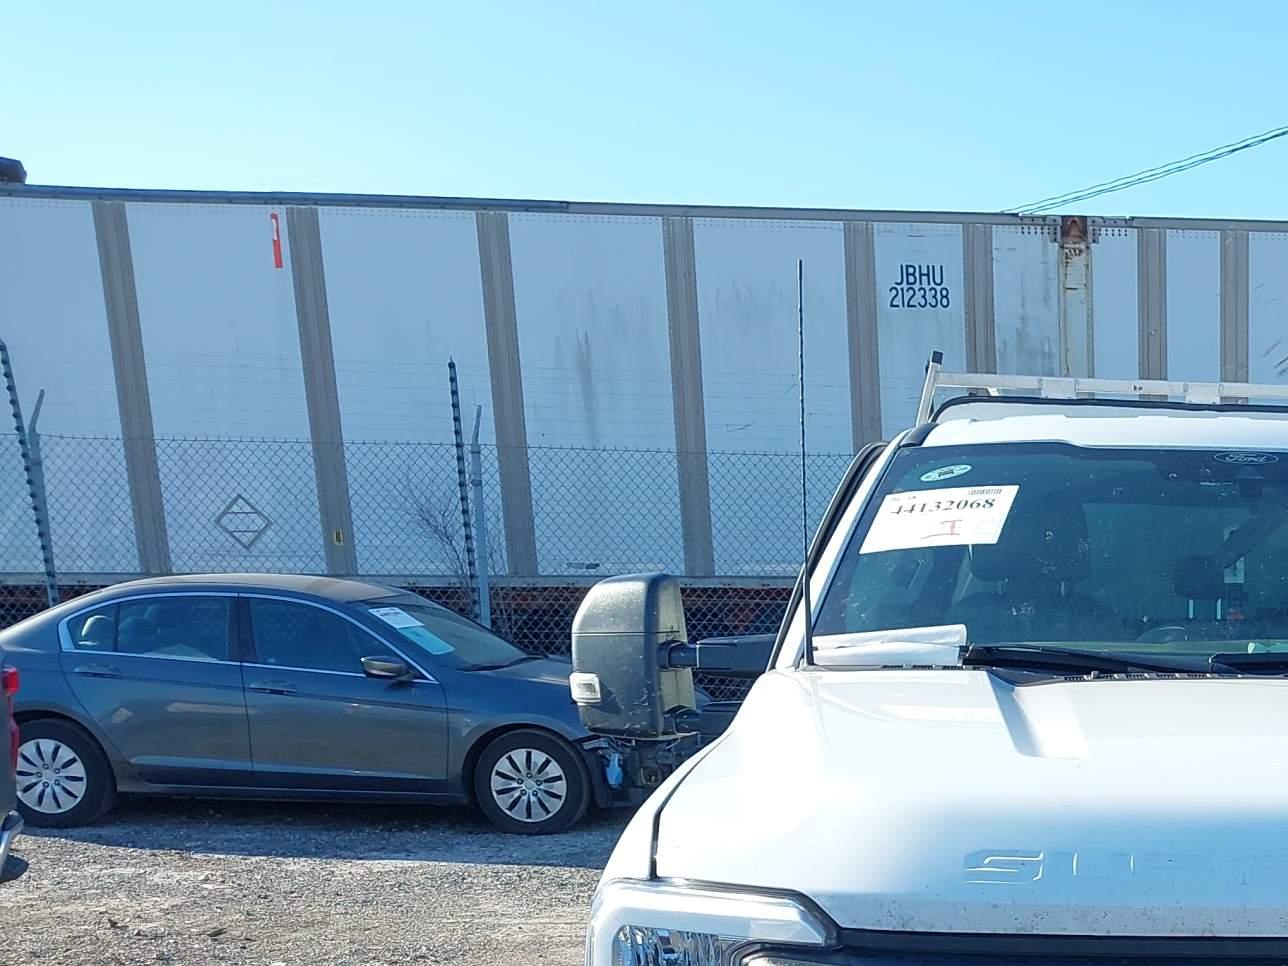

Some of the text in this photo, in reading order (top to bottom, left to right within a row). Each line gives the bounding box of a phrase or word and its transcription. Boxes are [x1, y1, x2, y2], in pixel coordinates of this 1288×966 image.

[894, 264, 944, 286] JBHU
[889, 287, 950, 308] 212338
[891, 498, 996, 515] 44132068
